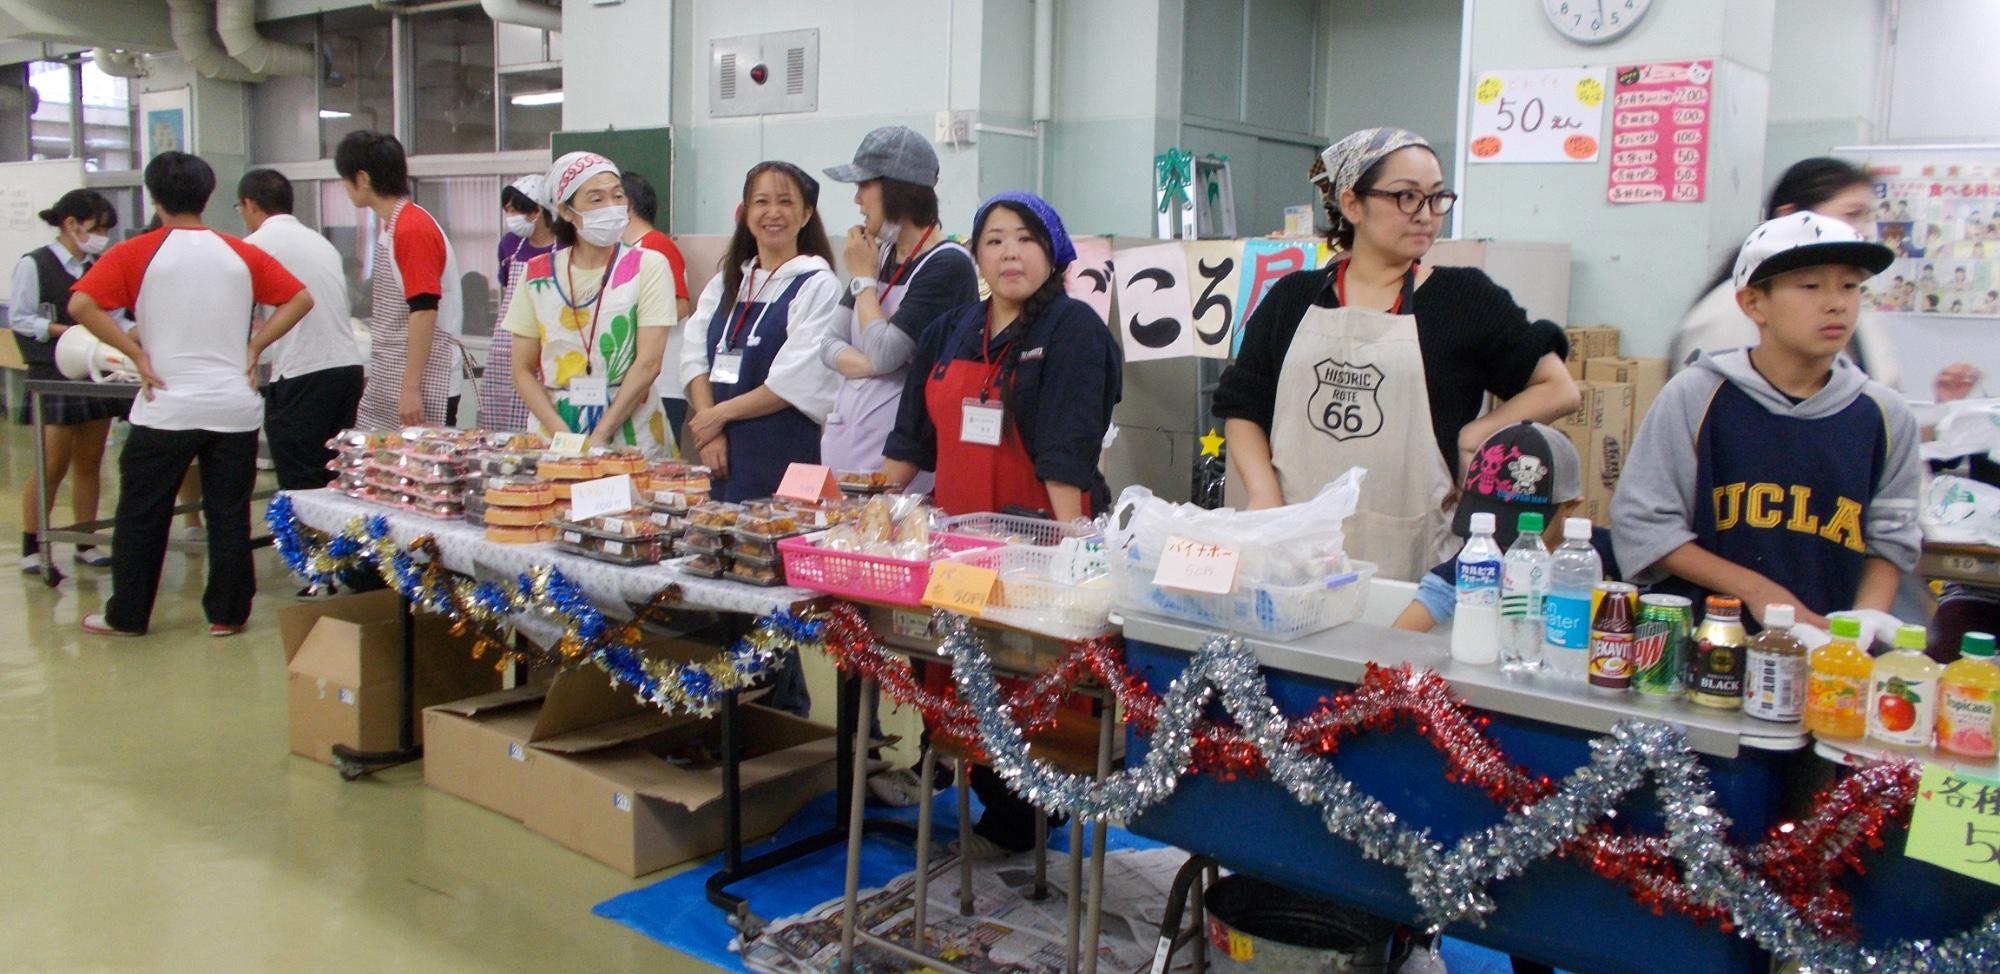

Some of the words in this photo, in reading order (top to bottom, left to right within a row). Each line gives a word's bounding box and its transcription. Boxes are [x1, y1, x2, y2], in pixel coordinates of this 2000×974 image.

[1323, 401, 1363, 433] 66
[1712, 480, 1867, 553] UCLA
[1461, 565, 1496, 577] カルピス
[1548, 613, 1580, 630] ater
[1700, 677, 1741, 691] BLACK
[1965, 821, 2000, 867] 5
